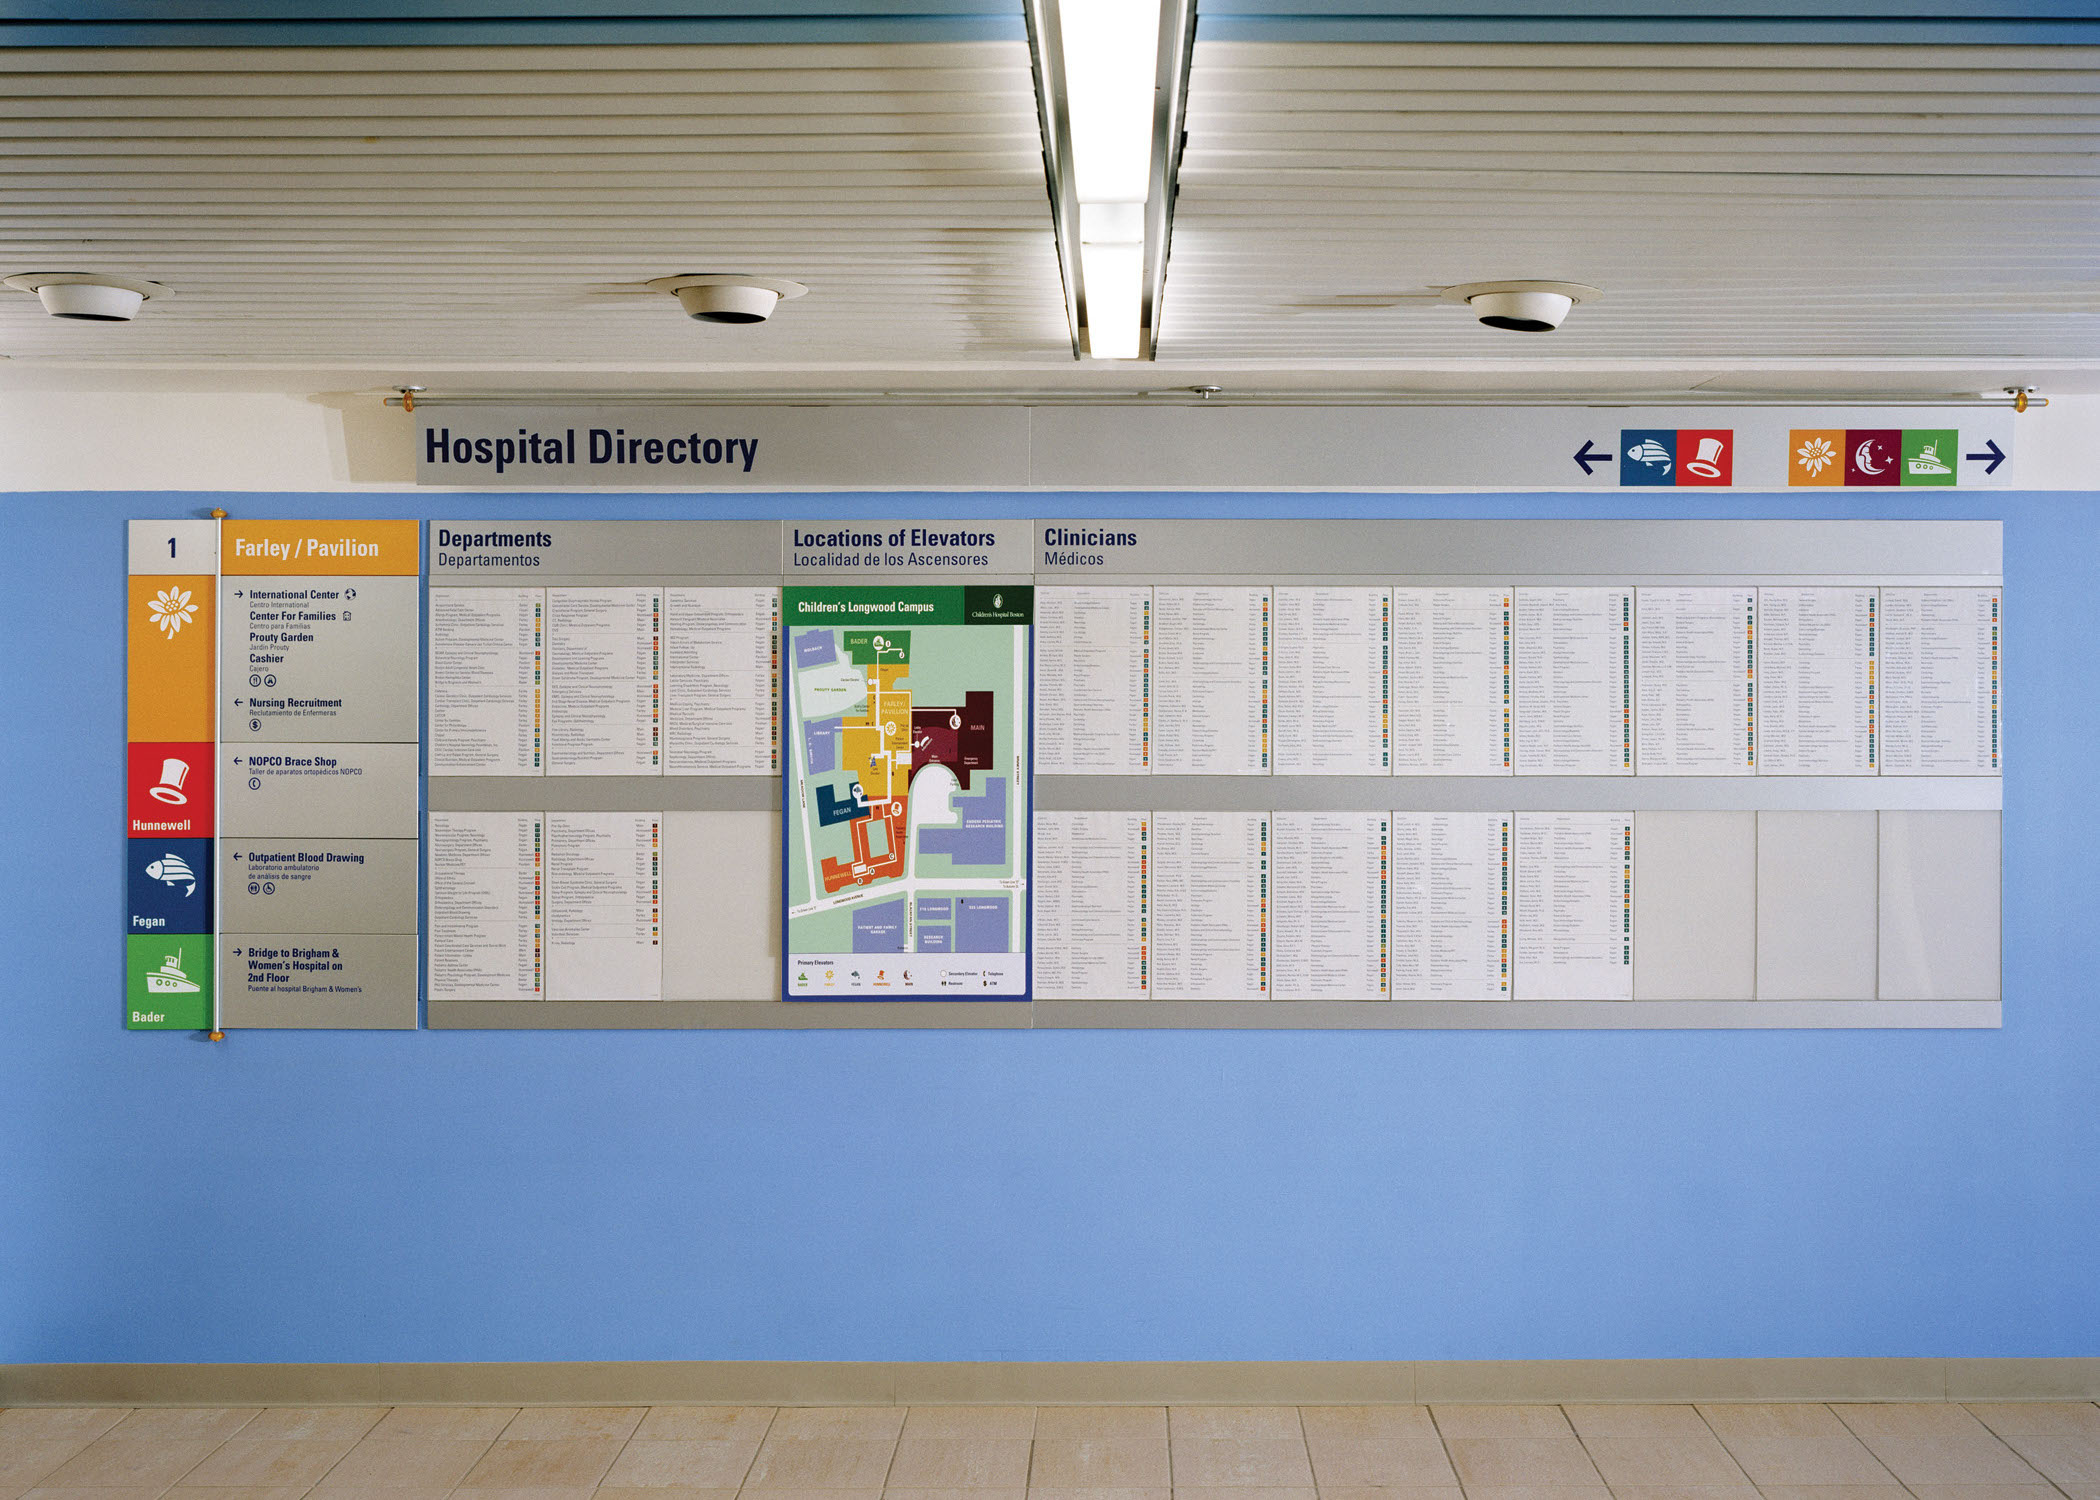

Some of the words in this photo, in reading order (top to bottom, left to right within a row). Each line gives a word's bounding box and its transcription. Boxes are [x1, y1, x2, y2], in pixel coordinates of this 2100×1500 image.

[426, 427, 575, 474] Hospital
[588, 427, 758, 474] Directory
[438, 530, 552, 550] Departments
[794, 530, 882, 547] Locations
[886, 530, 906, 547] of
[911, 530, 995, 547] Elevators
[1044, 528, 1137, 546] Clinicians
[168, 538, 176, 558] 1
[235, 538, 291, 560] Farley
[294, 538, 302, 558] /
[307, 538, 379, 557] Pavilion
[438, 552, 540, 569] Departamentos
[794, 552, 860, 567] Localidad
[864, 552, 880, 567] de
[884, 552, 904, 567] los
[908, 552, 988, 567] Ascensores
[1045, 552, 1104, 566] Médicos
[250, 590, 307, 599] International
[310, 590, 339, 599] Center
[798, 601, 846, 612] Children's
[848, 601, 895, 614] Longwood
[898, 601, 934, 614] Campus
[250, 611, 279, 620] Center
[282, 611, 296, 620] For
[298, 611, 336, 620] Families
[250, 633, 278, 643] Prouty
[281, 633, 314, 642] Garden
[250, 654, 284, 663] Cashier
[250, 698, 285, 709] Nursing
[288, 698, 342, 707] Recruitment
[249, 756, 282, 766] NOPCO
[285, 756, 312, 766] Brace
[314, 756, 337, 768] Shop
[833, 807, 851, 816] FEGAN
[133, 819, 191, 831] Hunnewell
[249, 852, 296, 864] Outpatient
[298, 852, 324, 862] Blood
[327, 852, 364, 864] Drawing
[133, 916, 165, 929] Fegan
[249, 948, 278, 959] Bridge
[280, 949, 289, 958] to
[292, 948, 330, 959] Brigham
[332, 949, 339, 958] &
[248, 961, 290, 970] Women's
[293, 961, 330, 972] Hospital
[248, 973, 264, 982] 2nd
[266, 973, 290, 982] Floor
[133, 1012, 165, 1022] Bader
